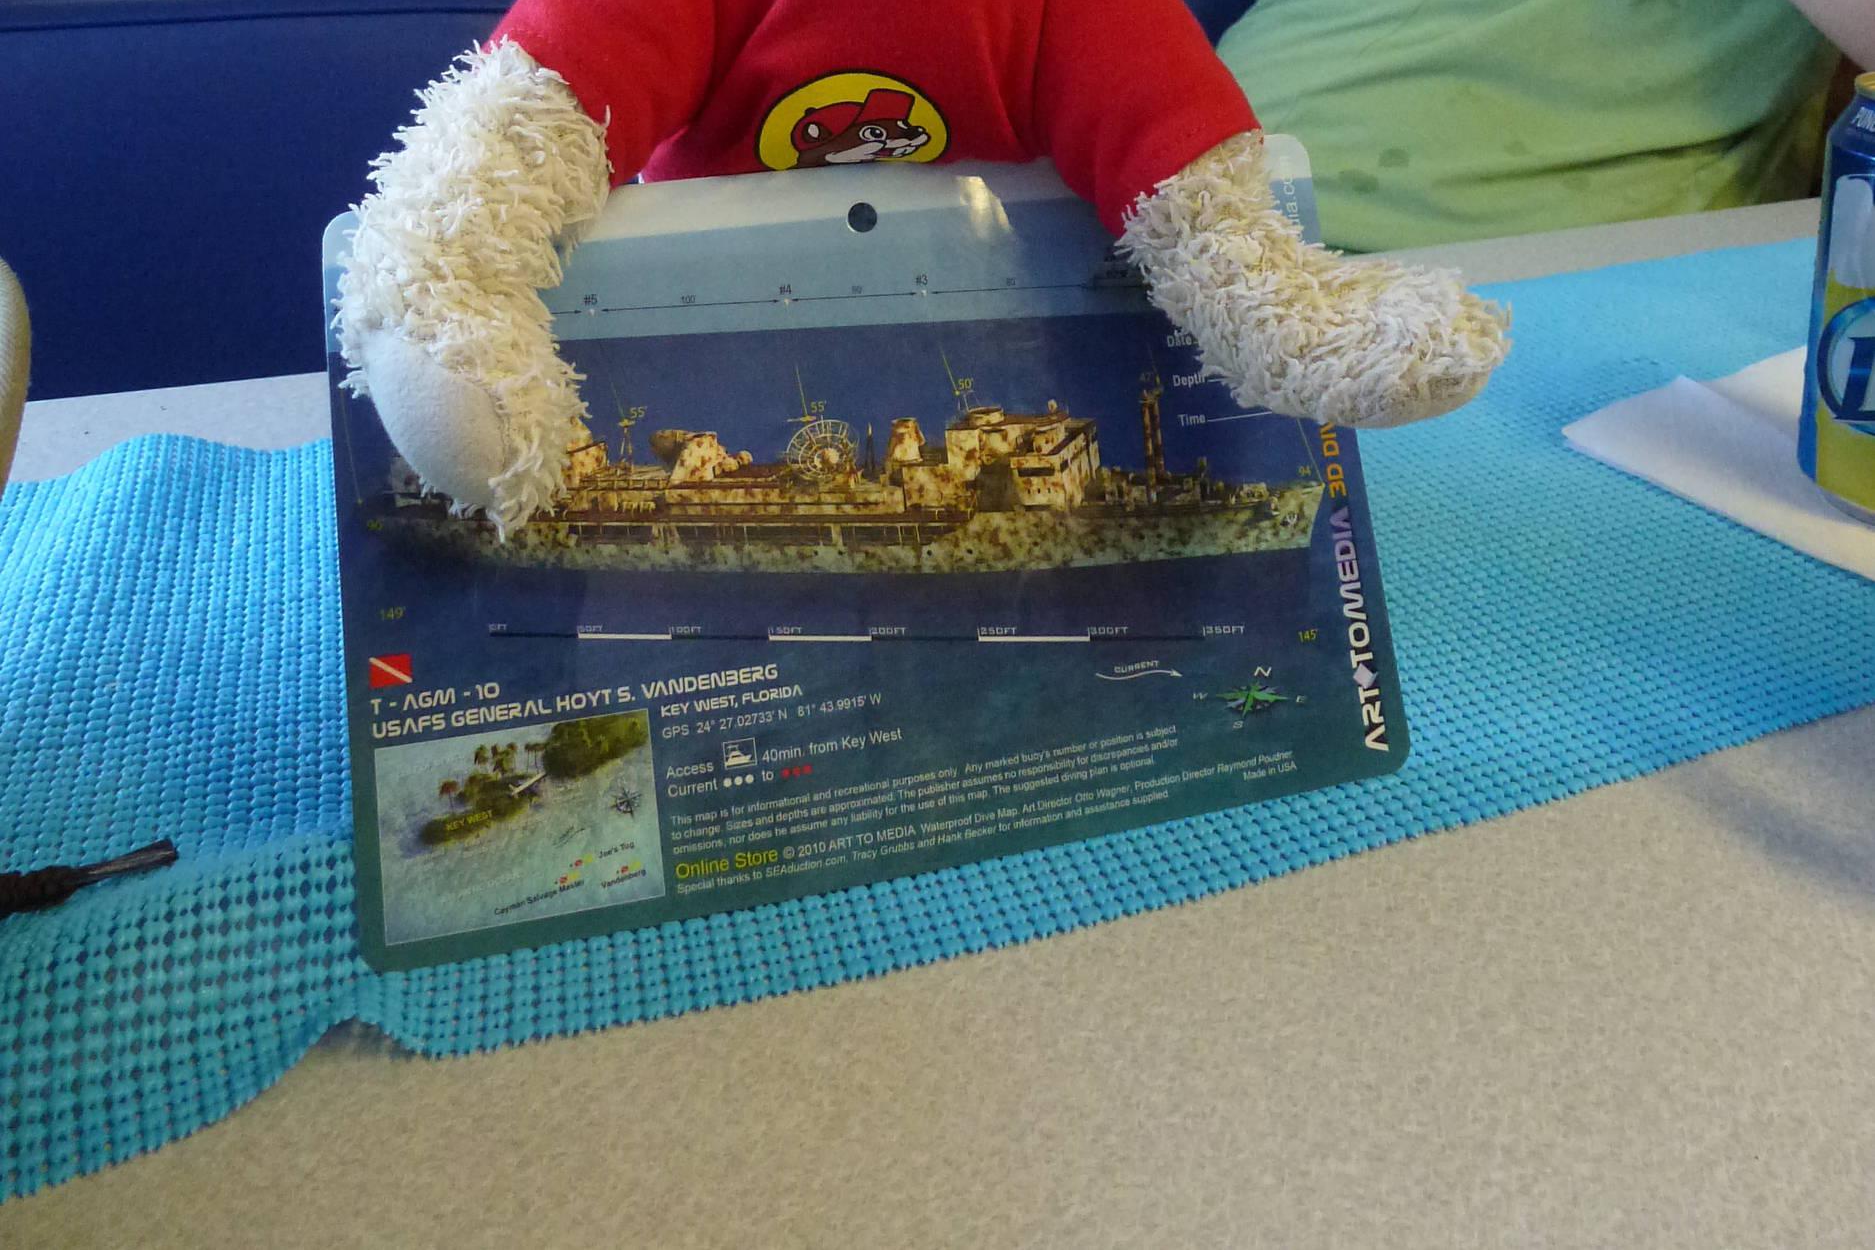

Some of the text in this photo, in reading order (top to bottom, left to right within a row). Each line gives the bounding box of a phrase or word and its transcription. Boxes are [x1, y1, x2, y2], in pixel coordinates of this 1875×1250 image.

[1173, 372, 1206, 389] Depth
[629, 405, 648, 419] 55'
[810, 400, 828, 413] 55'
[1178, 413, 1206, 427] Time
[1325, 462, 1347, 499] 3D
[980, 626, 1018, 636] 250FT
[1090, 626, 1129, 636] 300FT
[1205, 625, 1246, 635] 350FT
[1114, 660, 1160, 674] CURRENT
[1254, 666, 1273, 677] N
[371, 682, 500, 715] T AGM 10
[373, 663, 778, 739] USAFS GENERAL HOYT S. VANDENBERG
[660, 684, 803, 718] KEY WEST, FLORIDA
[662, 725, 689, 739] GPS
[697, 719, 715, 734] 24°
[778, 708, 788, 720] N
[797, 704, 816, 718] 81°
[869, 693, 882, 704] W
[666, 727, 903, 779] Access 40min. from Key West
[667, 770, 774, 798] Current to
[672, 814, 692, 826] This
[695, 810, 717, 824] map
[720, 808, 729, 818] is
[732, 805, 745, 817] for
[747, 793, 811, 813] informational
[813, 789, 831, 801] and
[834, 781, 890, 797] recreational
[892, 771, 936, 790] purposes
[965, 763, 983, 775] Any
[985, 756, 1019, 770] marked
[1053, 742, 1086, 757] number
[1088, 741, 1098, 750] or
[1100, 734, 1135, 750] position
[1146, 725, 1177, 740] subject
[1243, 760, 1297, 781] Made in USA
[672, 737, 1178, 840] to Sizes and depths are The publisher assumes no responsibility for discrepancies and/or
[675, 856, 730, 879] Online
[735, 849, 778, 869] Store
[798, 841, 826, 857] 2010
[828, 835, 853, 851] ART
[856, 832, 874, 846] TO
[877, 824, 916, 842] MEDIA
[920, 813, 973, 834] Waterproof
[974, 810, 995, 823] Dive
[1022, 801, 1037, 813] Art
[1037, 795, 1073, 811] Director
[1075, 792, 1094, 803] Otto
[1134, 774, 1181, 791] Production
[1182, 766, 1216, 782] Director
[1217, 756, 1257, 774] Raymond
[729, 764, 1108, 845] nor does he assume any liability for the use of this The suggested diving plan
[446, 810, 492, 831] KEY WEST
[676, 789, 1169, 894] Special thanks to Tracy Grubbs and Hank Becker for information and assistance supplied
[601, 868, 646, 889] Vandenberg
